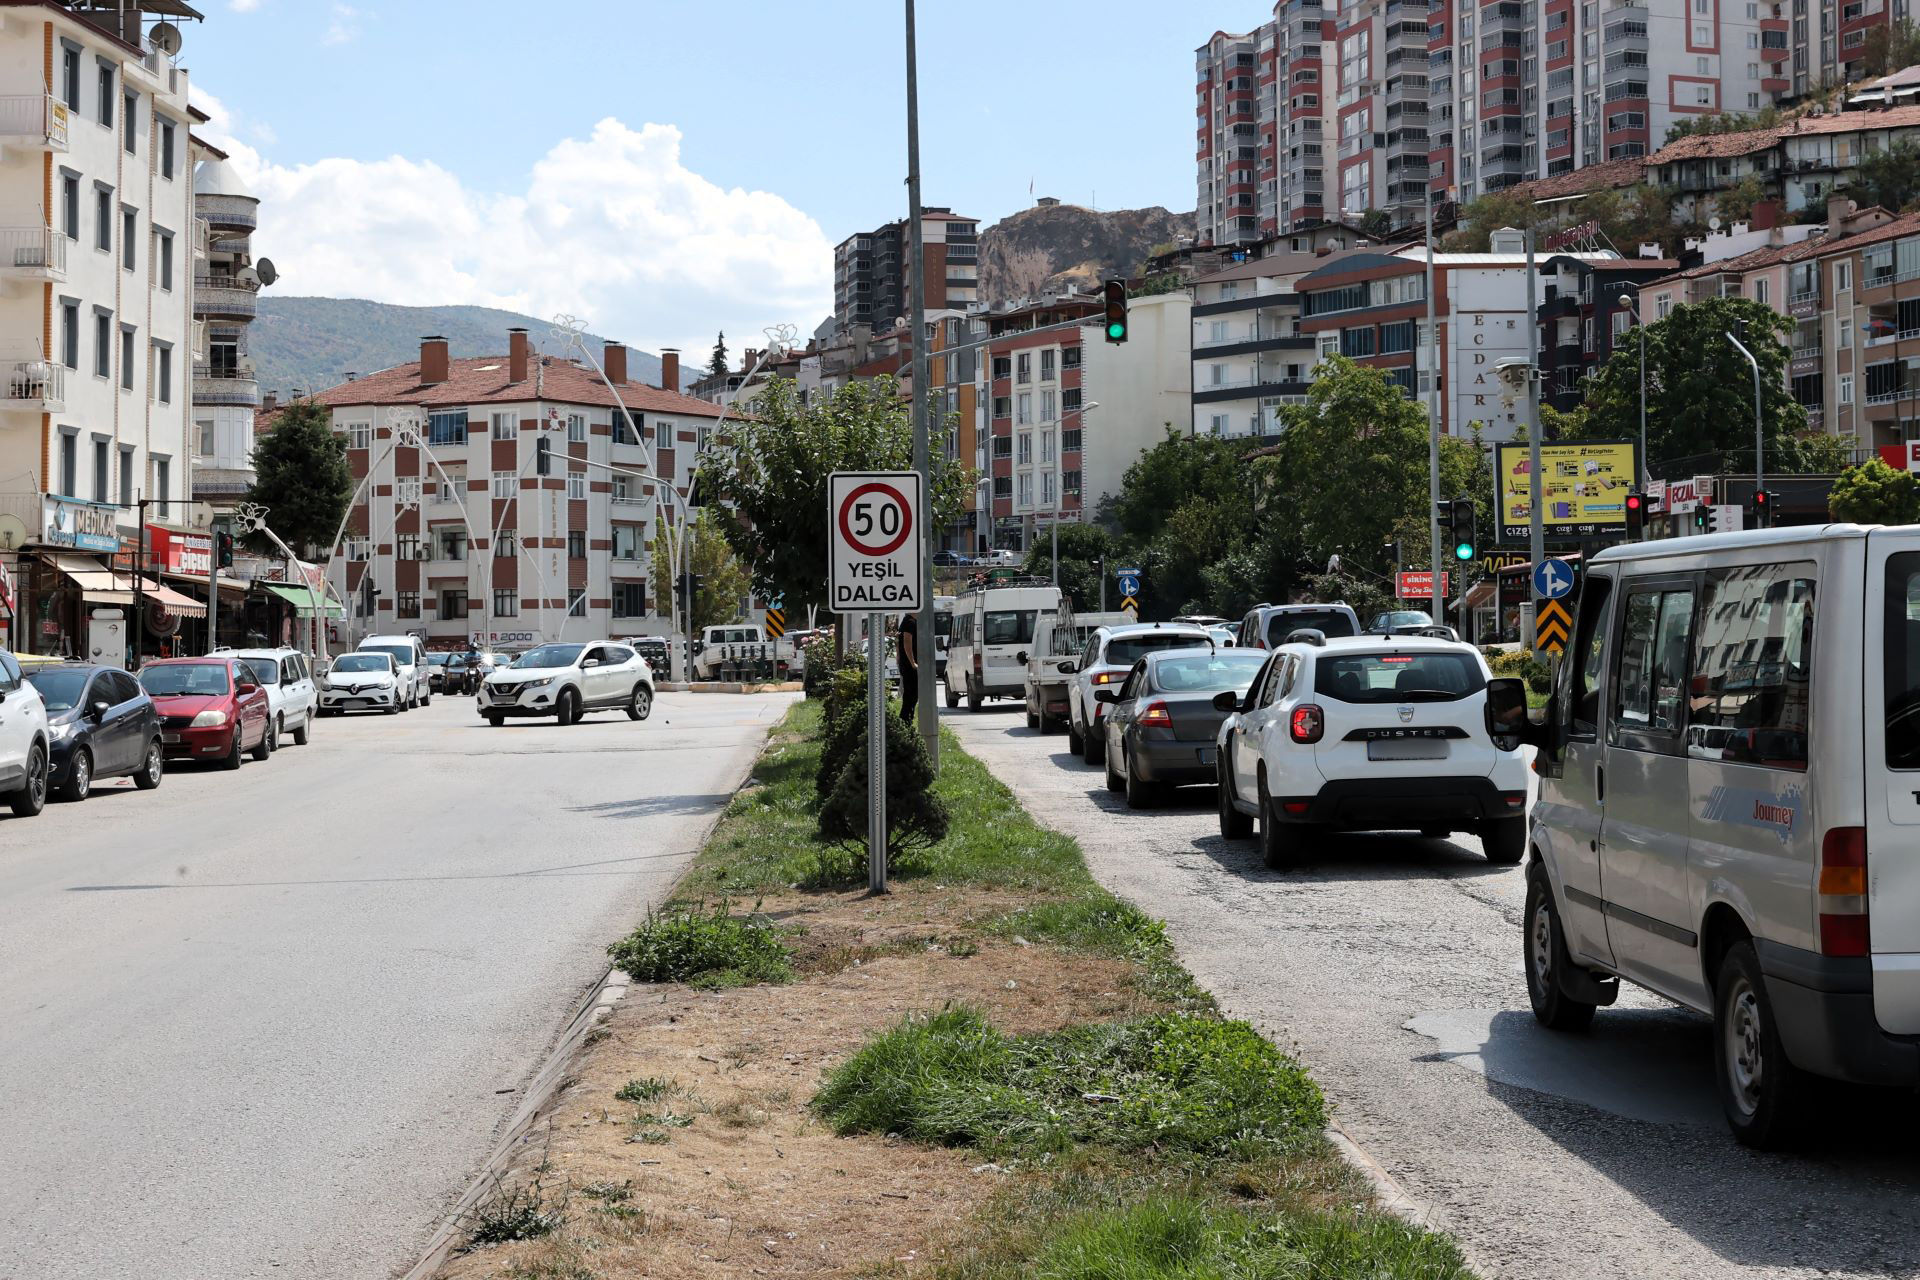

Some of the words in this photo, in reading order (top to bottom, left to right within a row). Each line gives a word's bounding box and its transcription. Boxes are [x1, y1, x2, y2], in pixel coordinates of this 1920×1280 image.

[1473, 314, 1486, 406] ECDAR
[1465, 419, 1494, 427] AT
[855, 503, 899, 536] 50
[848, 558, 904, 581] YEŞİL
[838, 584, 914, 602] DALGA
[500, 632, 532, 641] 2000
[1367, 729, 1446, 738] DUSTER
[1753, 799, 1794, 830] Journey
